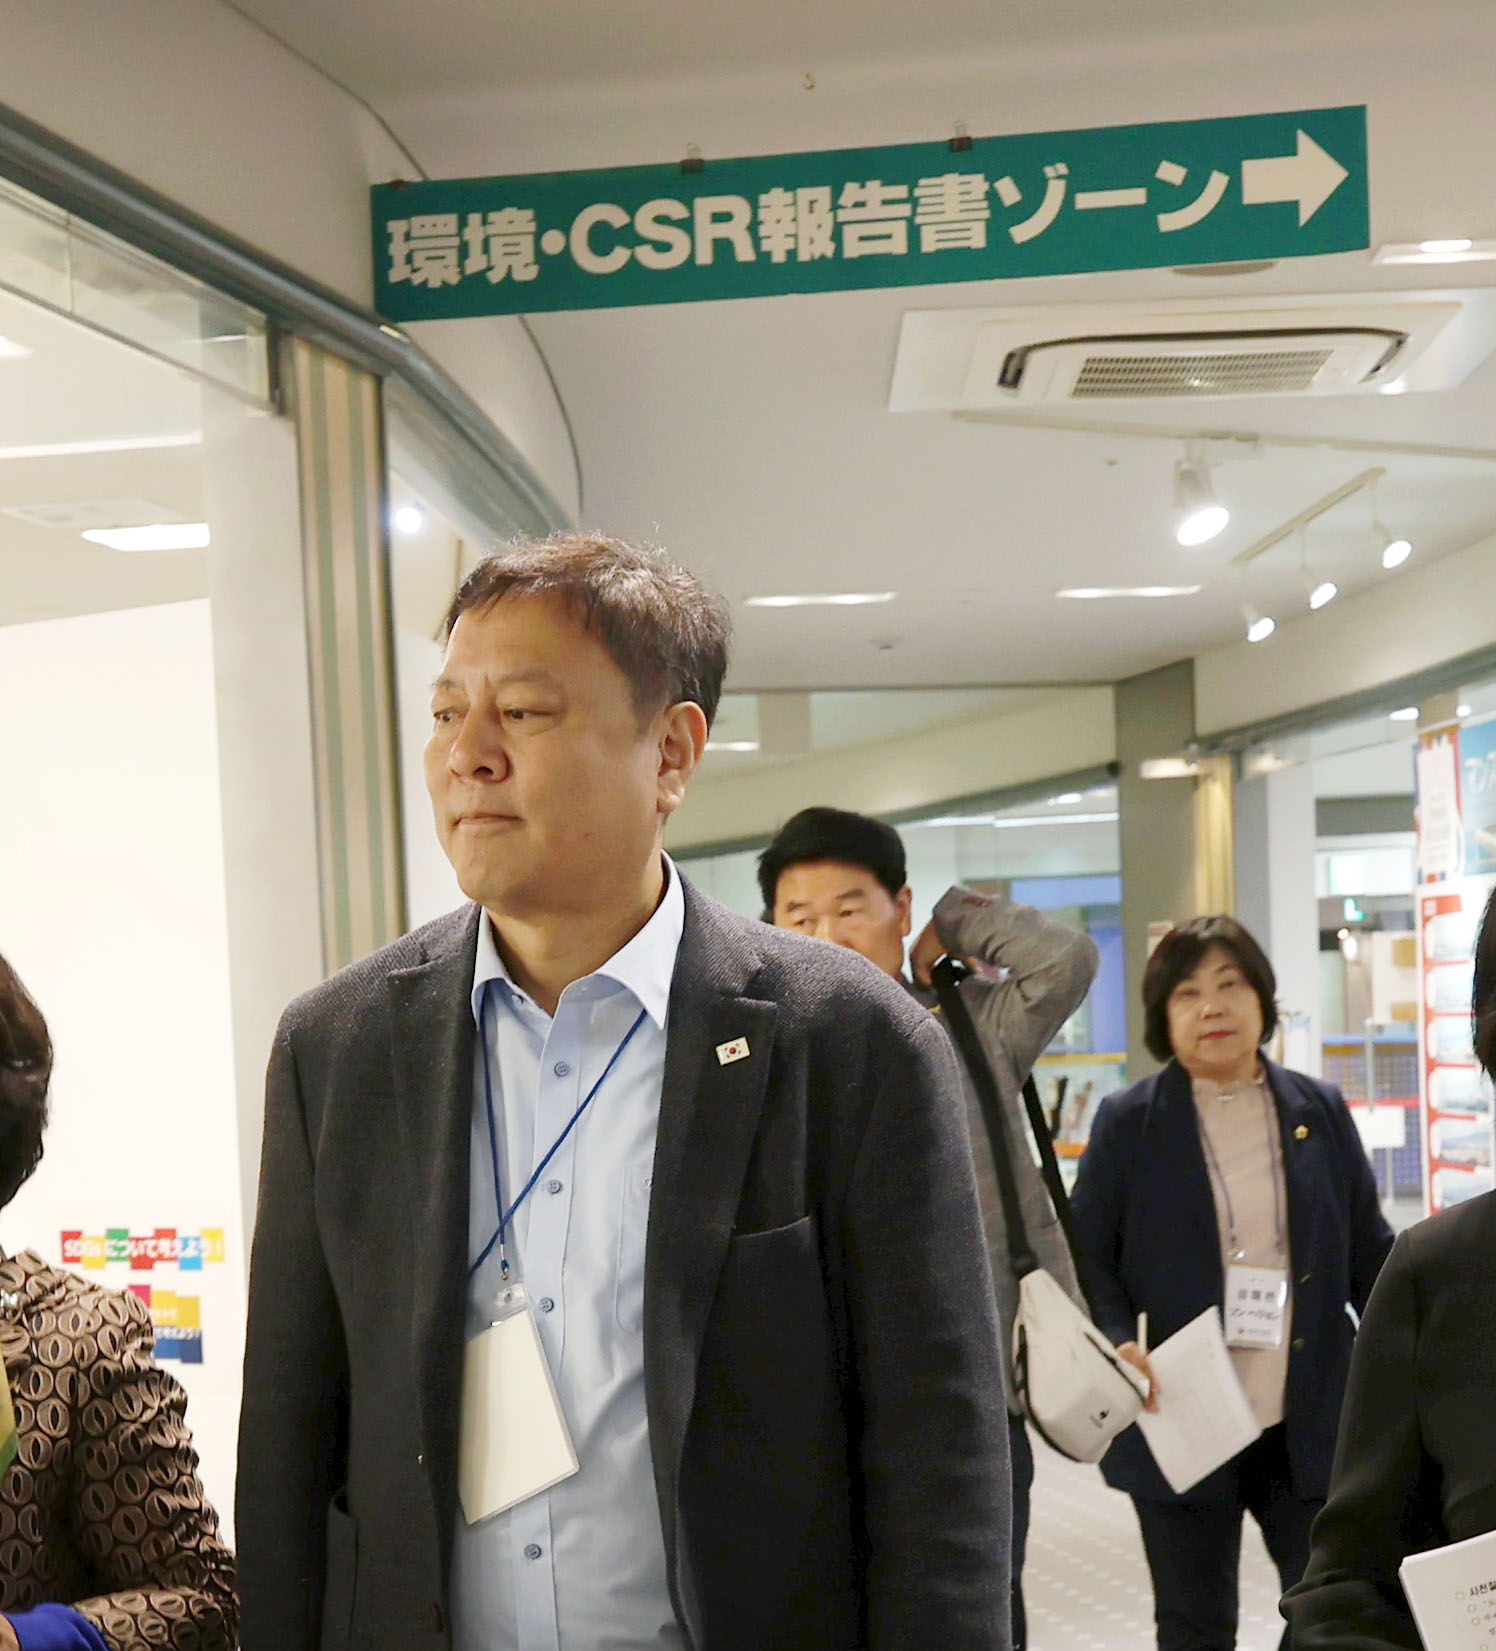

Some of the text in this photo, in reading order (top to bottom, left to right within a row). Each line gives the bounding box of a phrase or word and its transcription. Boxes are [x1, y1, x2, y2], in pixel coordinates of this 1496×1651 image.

[386, 158, 1231, 290] 環境・CSR報告書ゾーン
